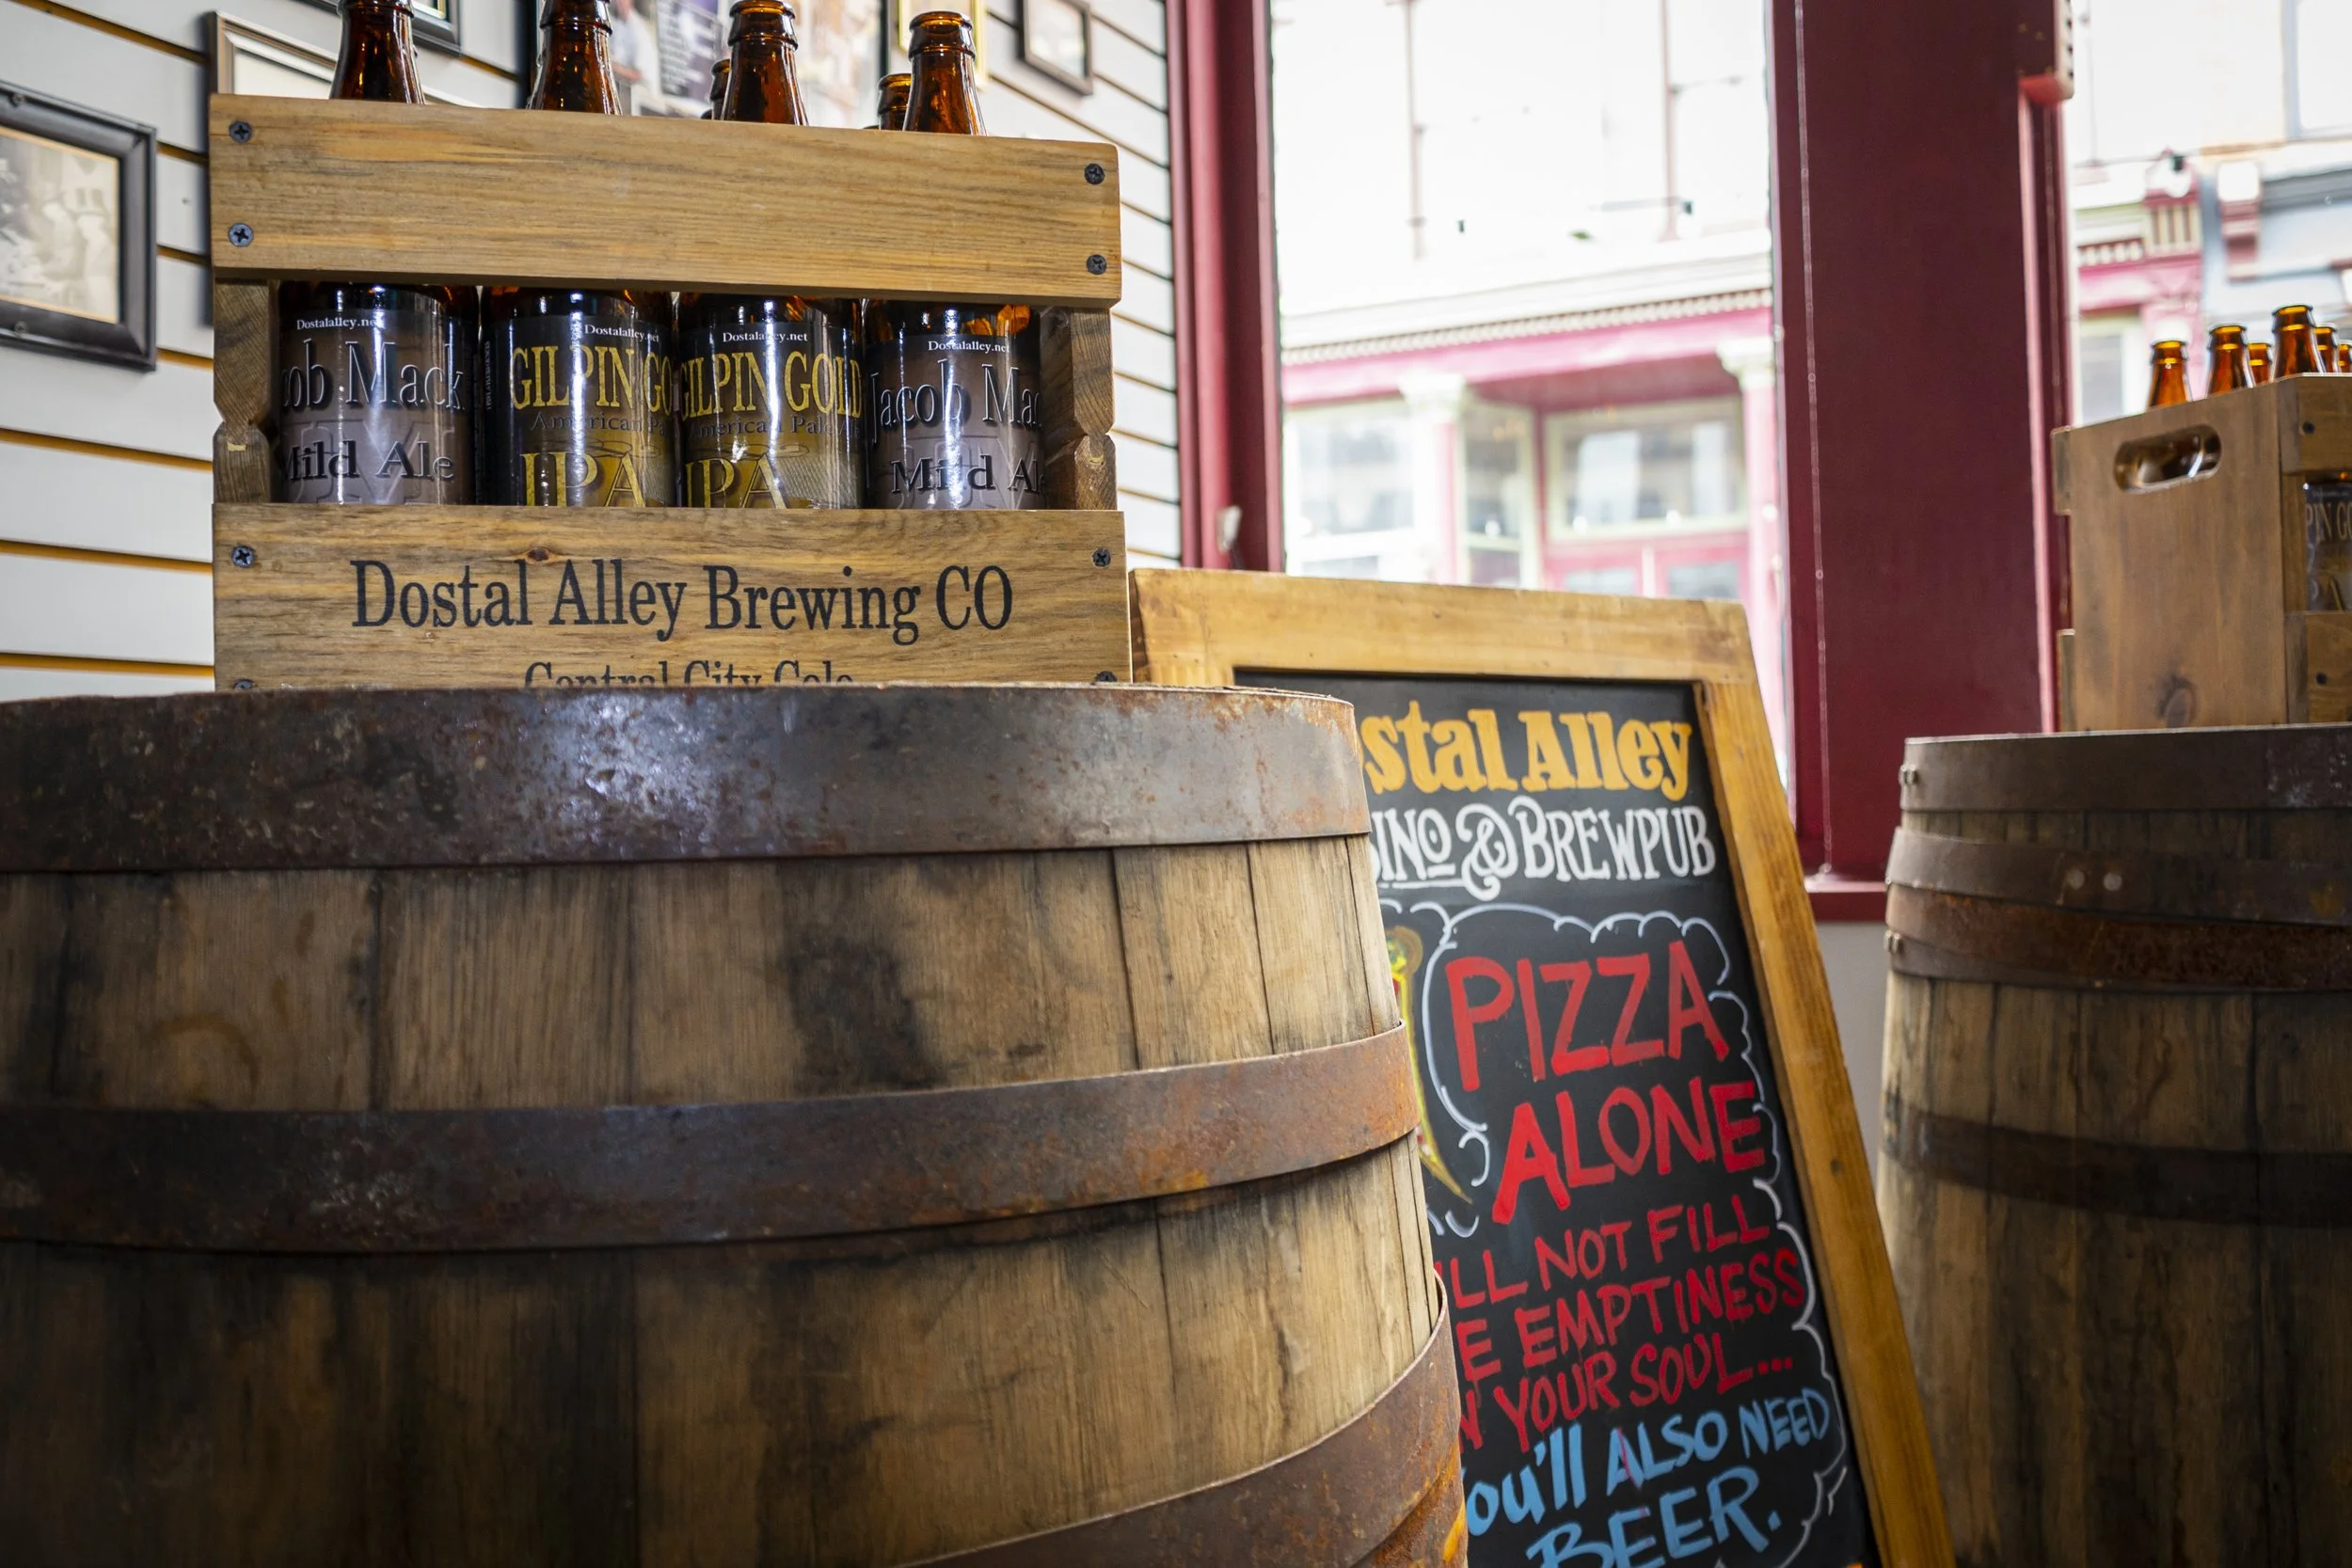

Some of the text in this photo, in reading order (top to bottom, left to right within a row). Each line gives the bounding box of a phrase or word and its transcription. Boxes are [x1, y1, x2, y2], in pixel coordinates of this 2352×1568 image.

[345, 341, 465, 410] Mack
[512, 346, 634, 410] GILPIN
[723, 331, 808, 342] Dostalaey.net
[531, 411, 643, 431] Amrican
[785, 351, 862, 419] GOLD
[871, 358, 966, 444] Jacob
[376, 440, 454, 482] Ale
[520, 451, 645, 507] IPA
[685, 453, 787, 509] IPA
[891, 453, 995, 494] Mid
[350, 559, 1013, 646] Dostal Alley Brewing CO
[1356, 700, 1693, 800] stal Alley
[1507, 795, 1717, 882] BREWPUB
[1445, 942, 1730, 1091] PIZZA
[1492, 1077, 1765, 1222] ALONE
[1534, 1220, 1632, 1291] NOT
[1646, 1195, 1770, 1263] FILL
[1514, 1247, 1805, 1369] EMPTINESS
[1493, 1355, 1619, 1454] YOUR
[1629, 1332, 1793, 1408] SOUL...
[1461, 1386, 1830, 1537] ou'll ALSO NEED
[1525, 1465, 1782, 1568] BEER.
